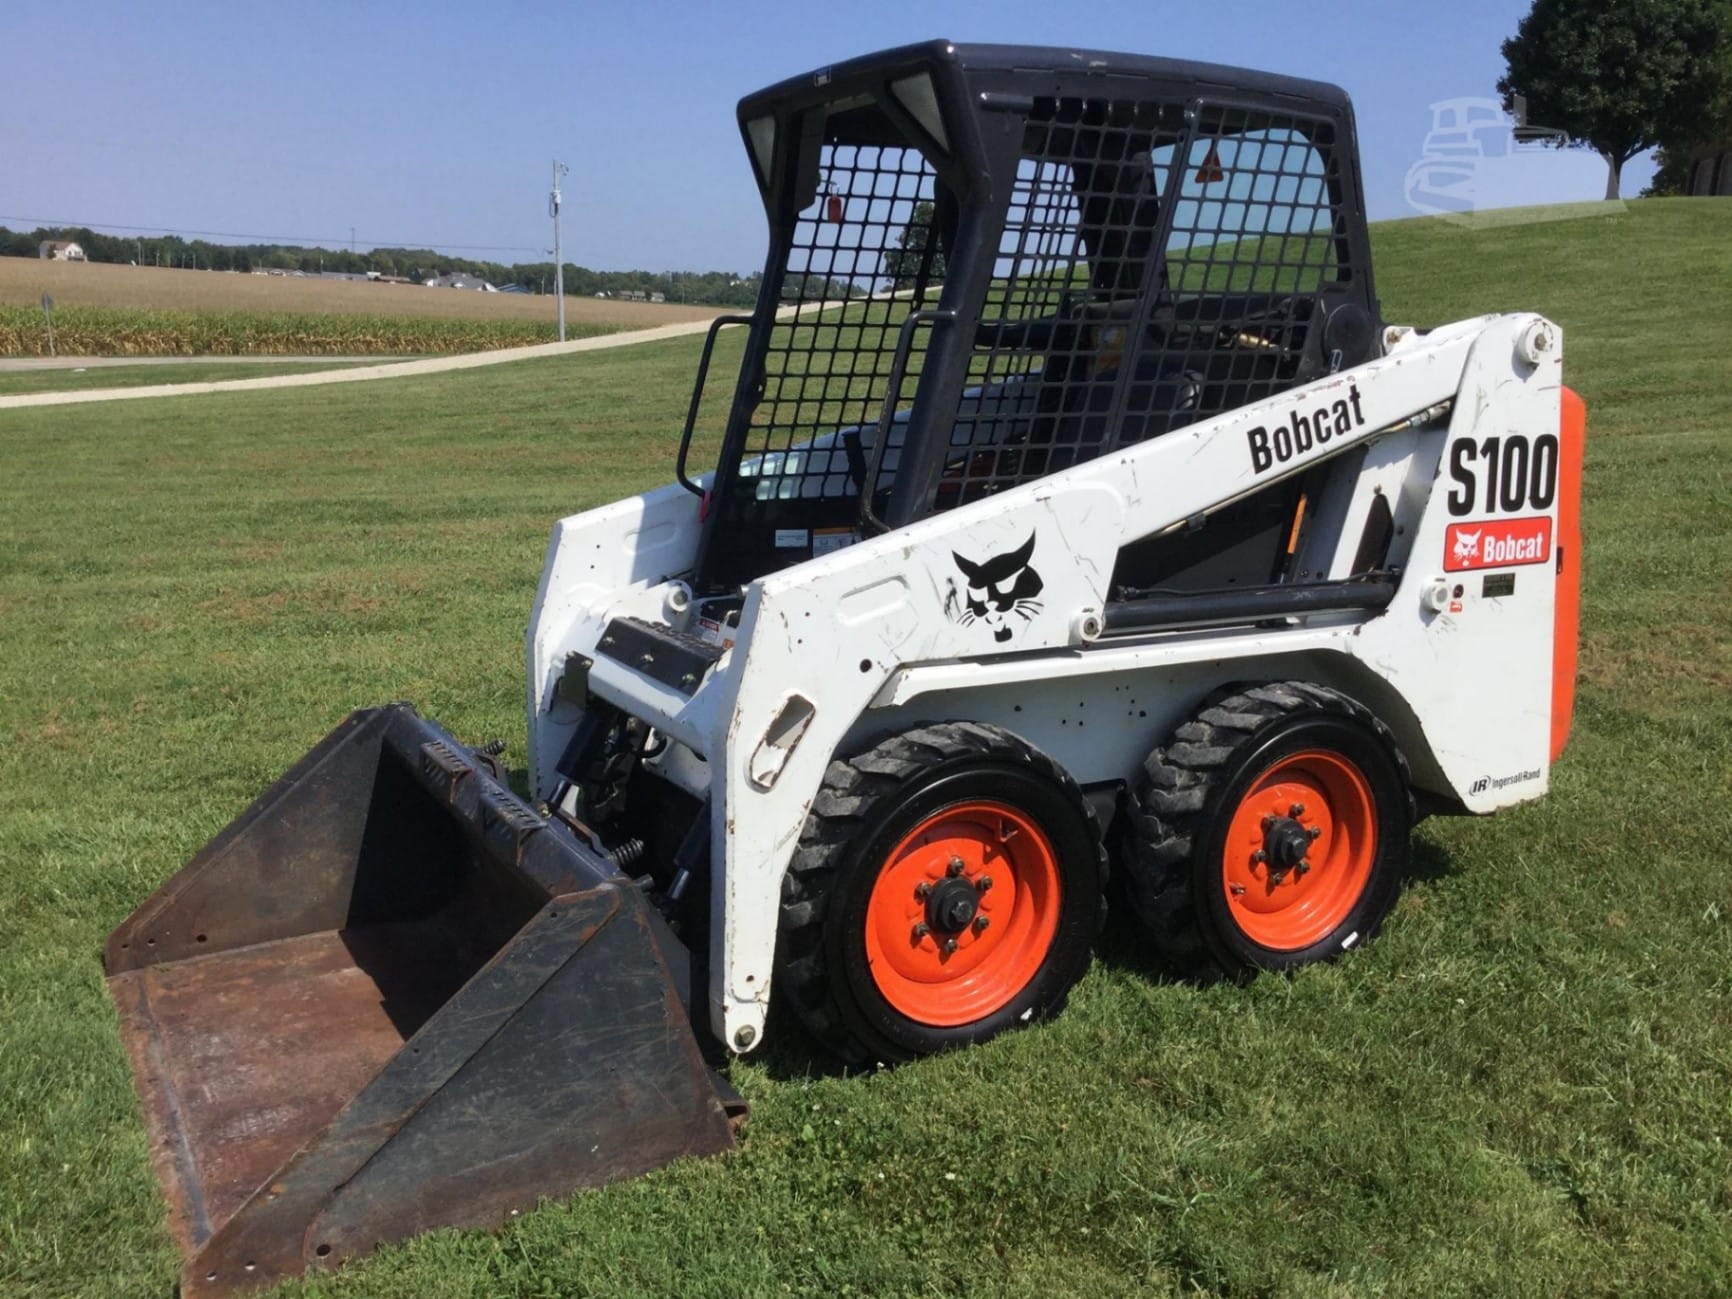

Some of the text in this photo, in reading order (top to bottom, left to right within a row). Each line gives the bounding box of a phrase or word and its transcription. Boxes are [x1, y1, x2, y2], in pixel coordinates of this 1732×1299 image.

[1247, 384, 1365, 474] Bobcat
[1448, 434, 1558, 516] S100
[1483, 532, 1544, 563] Bobcat
